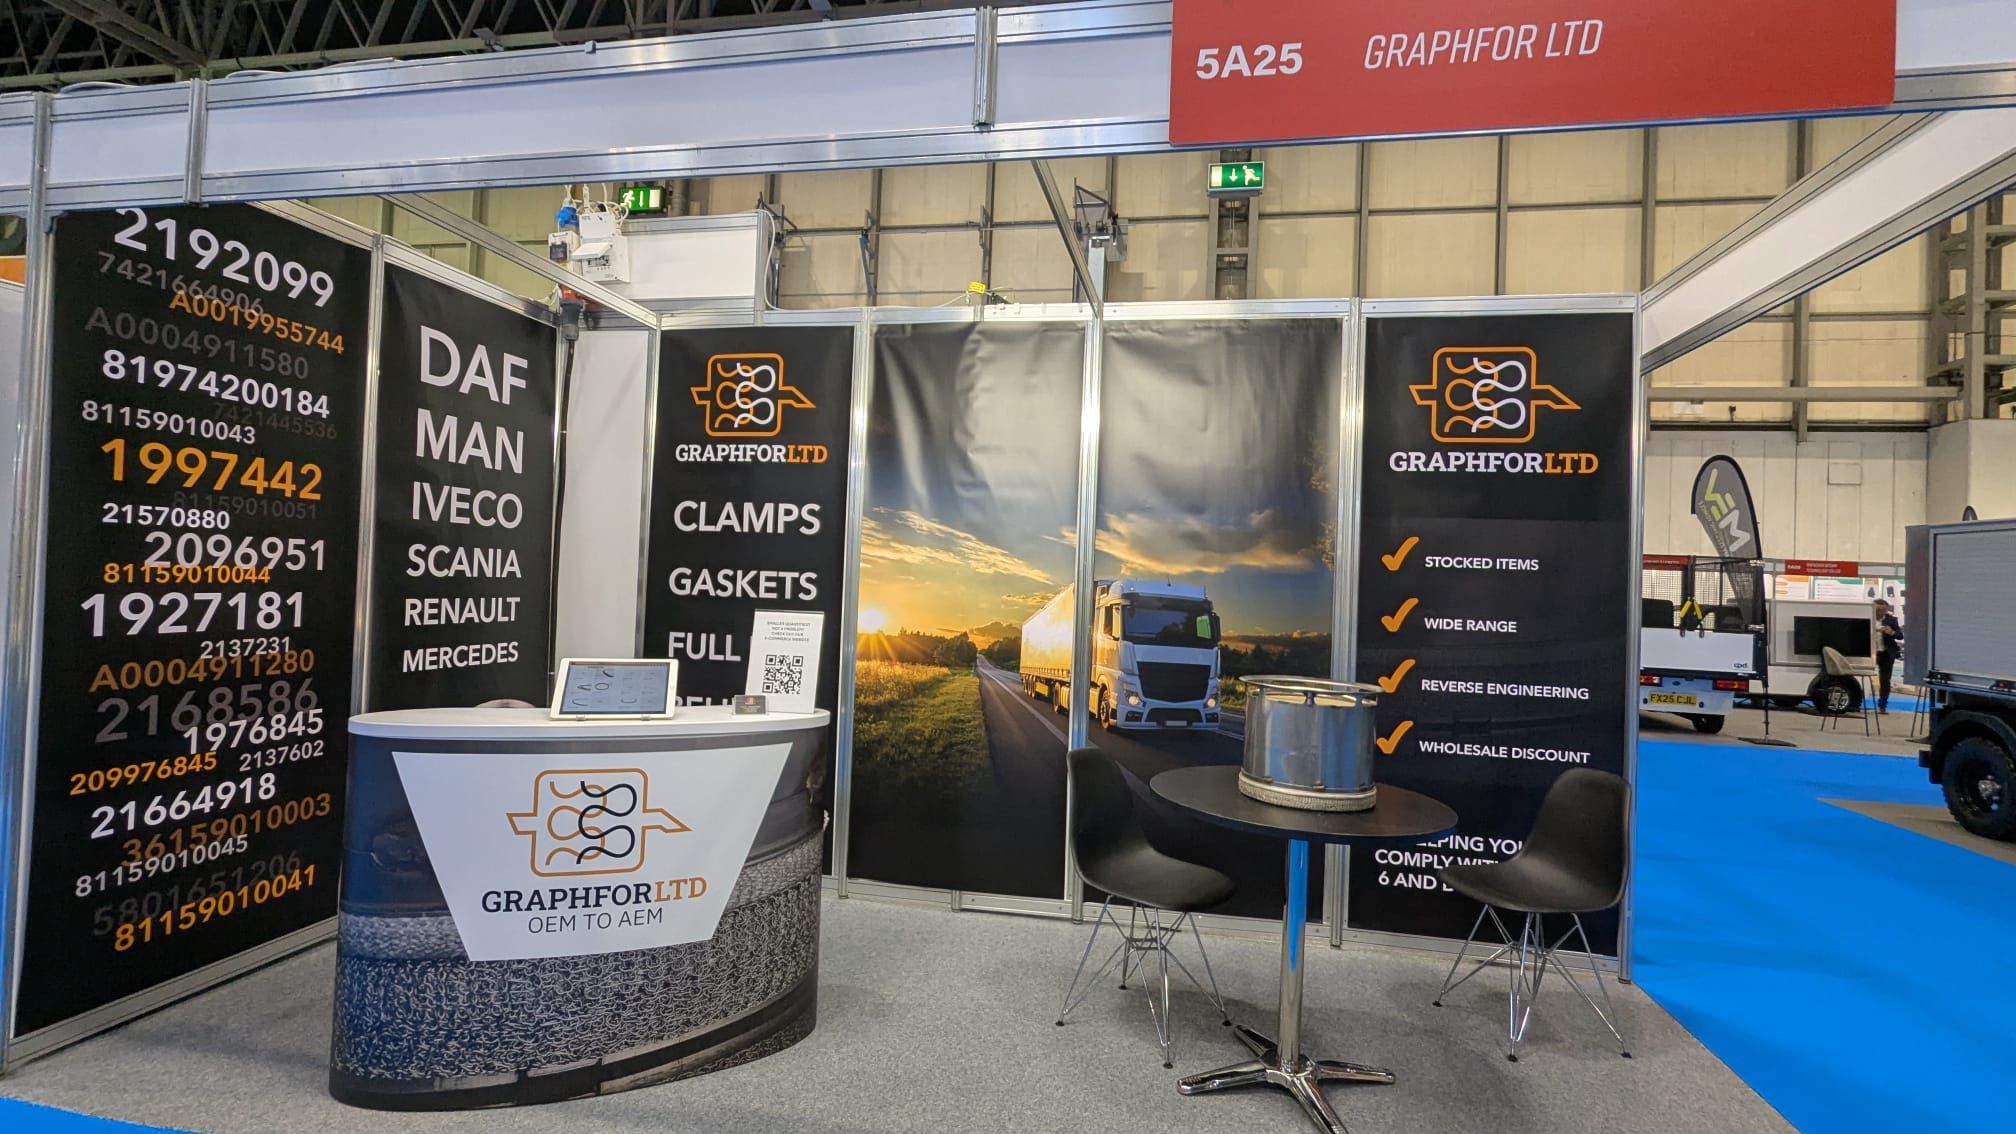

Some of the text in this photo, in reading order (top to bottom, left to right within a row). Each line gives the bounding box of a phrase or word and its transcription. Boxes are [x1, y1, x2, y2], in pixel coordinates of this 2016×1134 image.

[1196, 42, 1303, 80] 5A25
[1364, 19, 1603, 70] GRAPHFOR LTD
[114, 207, 334, 307] 2192099
[169, 289, 345, 353] A0019955744
[84, 306, 309, 380] A0004911580
[420, 325, 528, 405] DAF
[102, 350, 330, 419] 81974200184
[82, 400, 256, 444] 81159010043
[415, 407, 524, 474] MAN
[101, 439, 322, 500] 1997442
[102, 503, 230, 530] 21570880
[412, 481, 523, 529] IVECO
[673, 500, 822, 535] CLAMPS
[144, 531, 325, 570] 2096951
[406, 543, 522, 578] SCANIA
[1425, 556, 1539, 572] STOCKED ITEMS
[103, 563, 270, 583] 81159010044
[668, 567, 817, 600] GASKETS
[81, 591, 303, 637] 1927181
[404, 597, 520, 627] RENAULT
[1425, 618, 1517, 633] WIDE RANGE
[200, 636, 290, 660] 2137231
[402, 641, 518, 673] MERCEDES
[668, 632, 741, 661] FULL
[88, 649, 314, 693] A0004911280
[1421, 679, 1589, 700] REVERSE ENGINEERING
[95, 678, 318, 744] 2168586
[183, 708, 324, 755] 1976845
[239, 740, 324, 772] 2137602
[1419, 740, 1590, 764] WHOLESALE DISCOUNT
[70, 751, 217, 795] 209976845
[90, 772, 275, 839] 21664918
[75, 834, 248, 897] 81159010045
[1375, 849, 1454, 869] COMPLY
[1488, 838, 1523, 855] YO
[1378, 871, 1390, 885] 6
[1394, 872, 1437, 890] AND
[114, 865, 316, 951] 81159010041
[528, 908, 663, 934] OEM TO AEM
